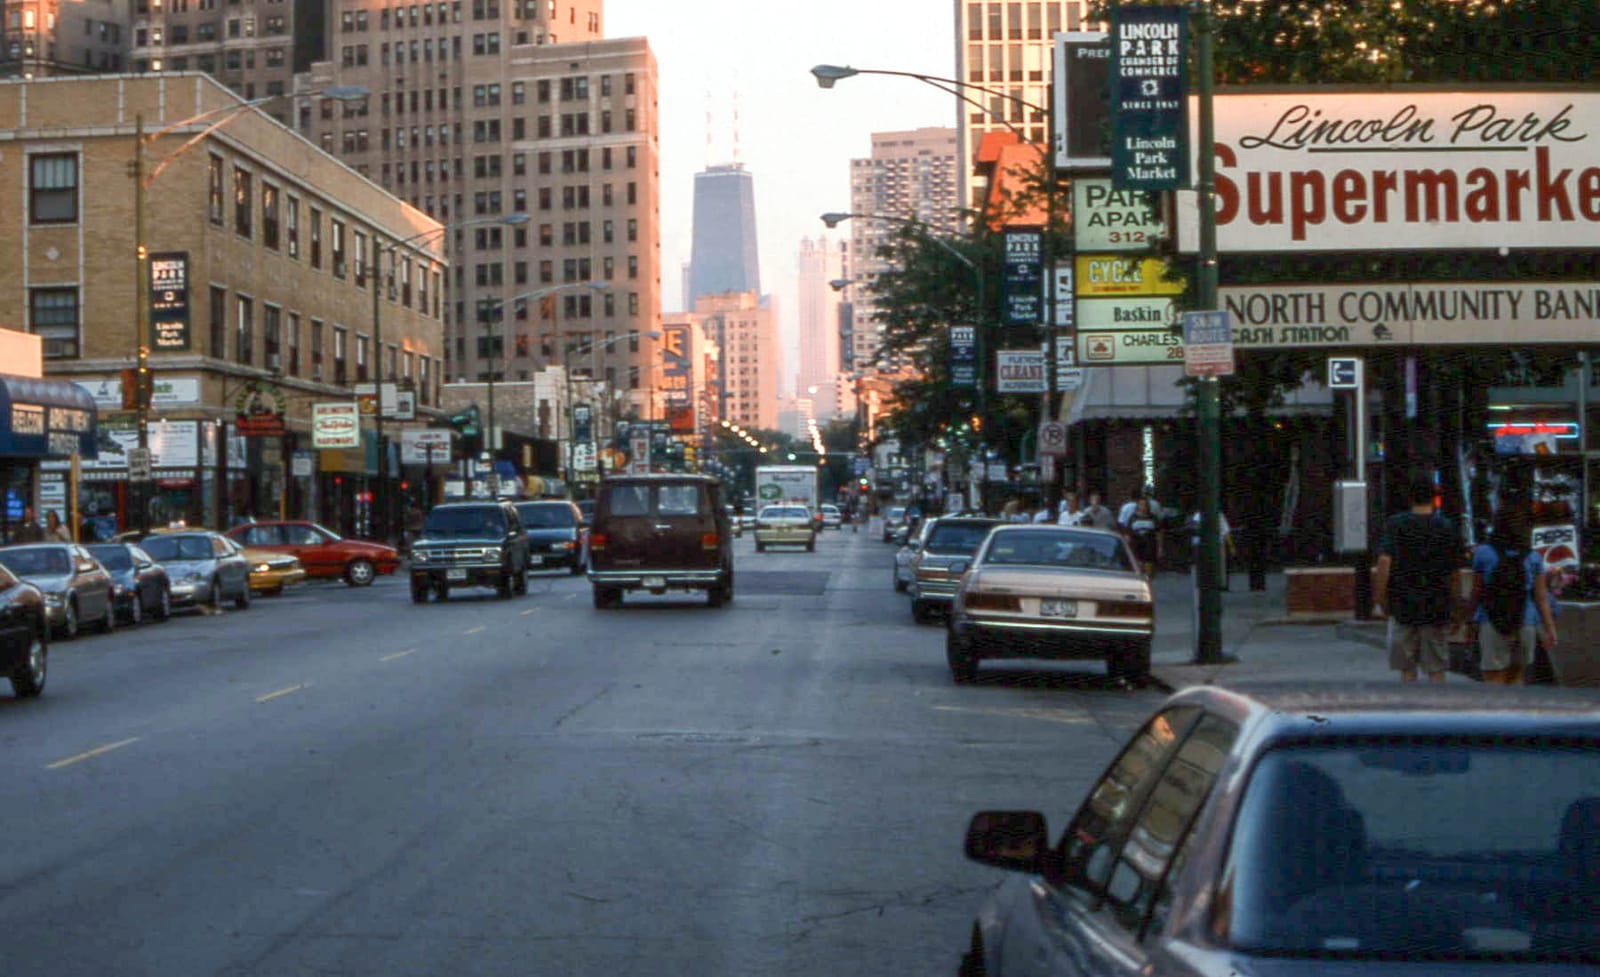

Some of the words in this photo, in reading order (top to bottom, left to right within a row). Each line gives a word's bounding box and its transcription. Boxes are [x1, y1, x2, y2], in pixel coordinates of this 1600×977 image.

[1120, 23, 1179, 40] LINCOLN
[1120, 40, 1179, 56] PARK
[1120, 57, 1164, 66] CHAMBER
[1166, 57, 1179, 66] OF
[1120, 67, 1179, 77] COMMERCE
[1122, 101, 1152, 110] SINCE
[1239, 104, 1435, 150] Lincoln
[1451, 103, 1588, 144] Park
[1126, 136, 1176, 150] Lincoln
[1135, 152, 1168, 165] Park
[1127, 167, 1176, 179] Market
[1113, 306, 1162, 322] Baskin
[1225, 293, 1326, 325] NORTH
[1338, 289, 1522, 323] COMMUNITY
[1122, 334, 1180, 347] CHARLES
[1279, 325, 1349, 343] STATION
